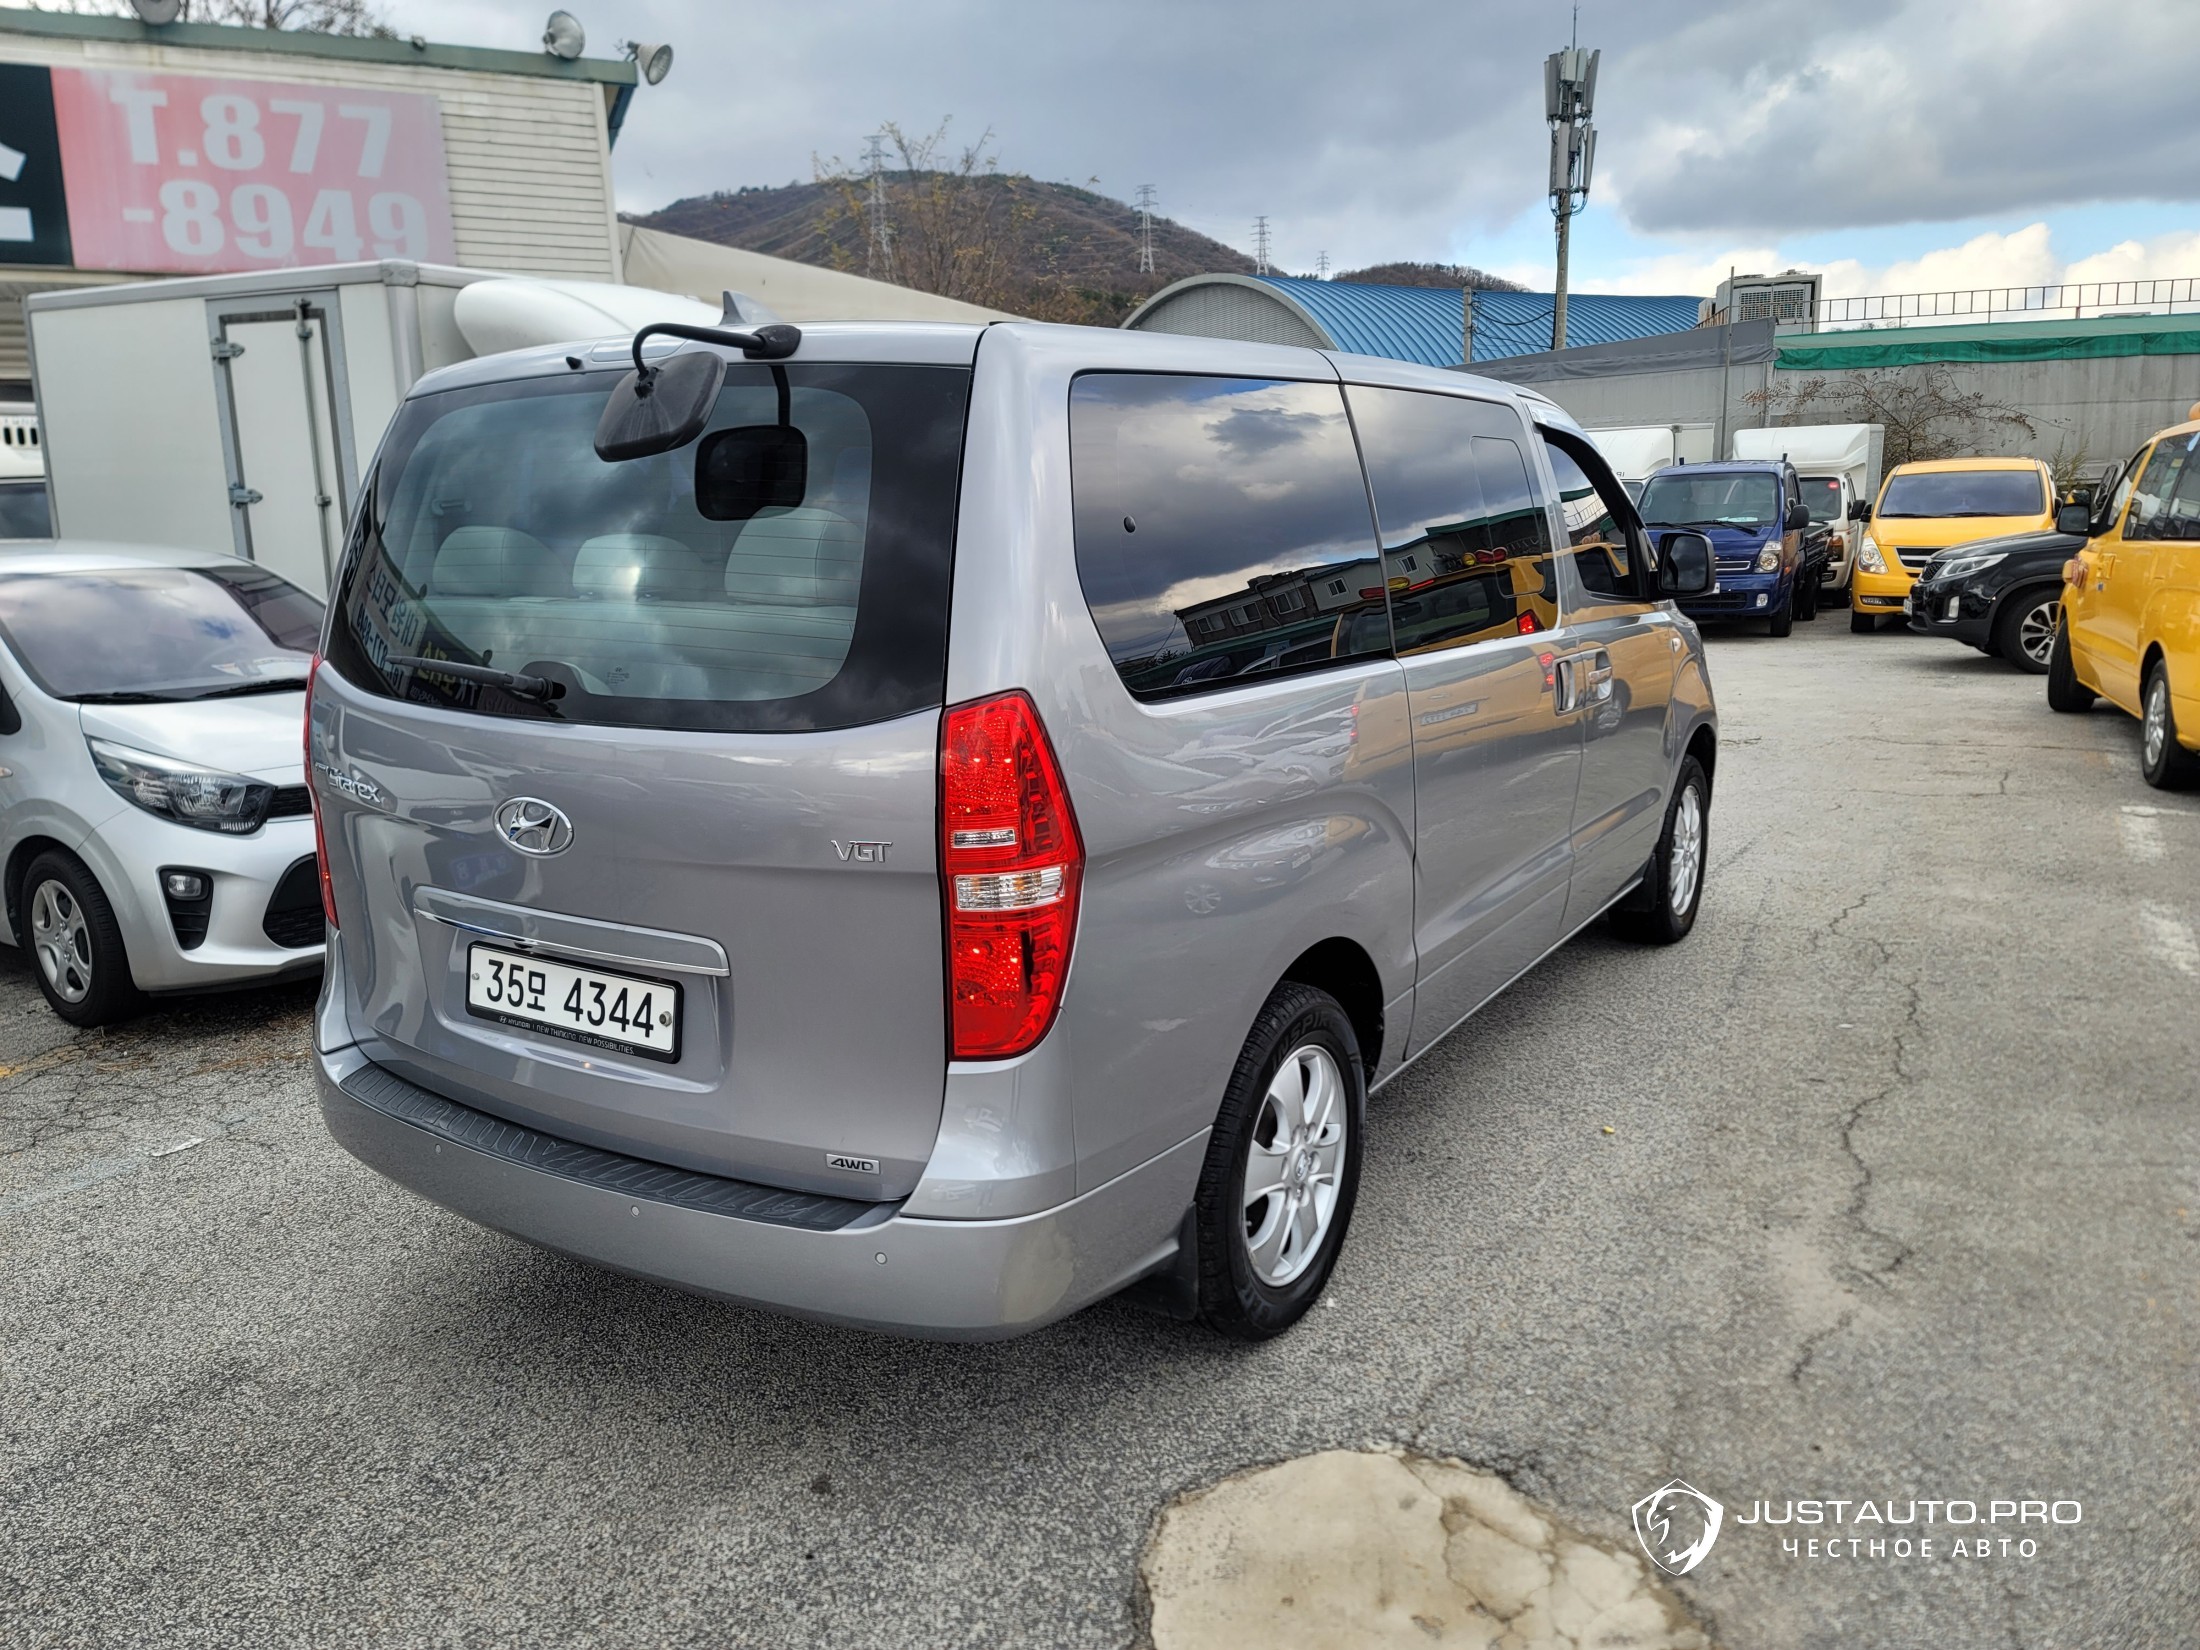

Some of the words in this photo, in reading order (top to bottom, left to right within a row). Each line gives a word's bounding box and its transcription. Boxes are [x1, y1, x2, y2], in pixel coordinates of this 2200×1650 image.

[110, 88, 392, 178] T.877
[123, 179, 430, 262] -8949
[831, 840, 893, 863] VGT
[486, 959, 546, 1012] 35모
[563, 977, 654, 1038] 4344
[536, 1024, 550, 1034] NEW
[830, 1158, 874, 1171] 4WD
